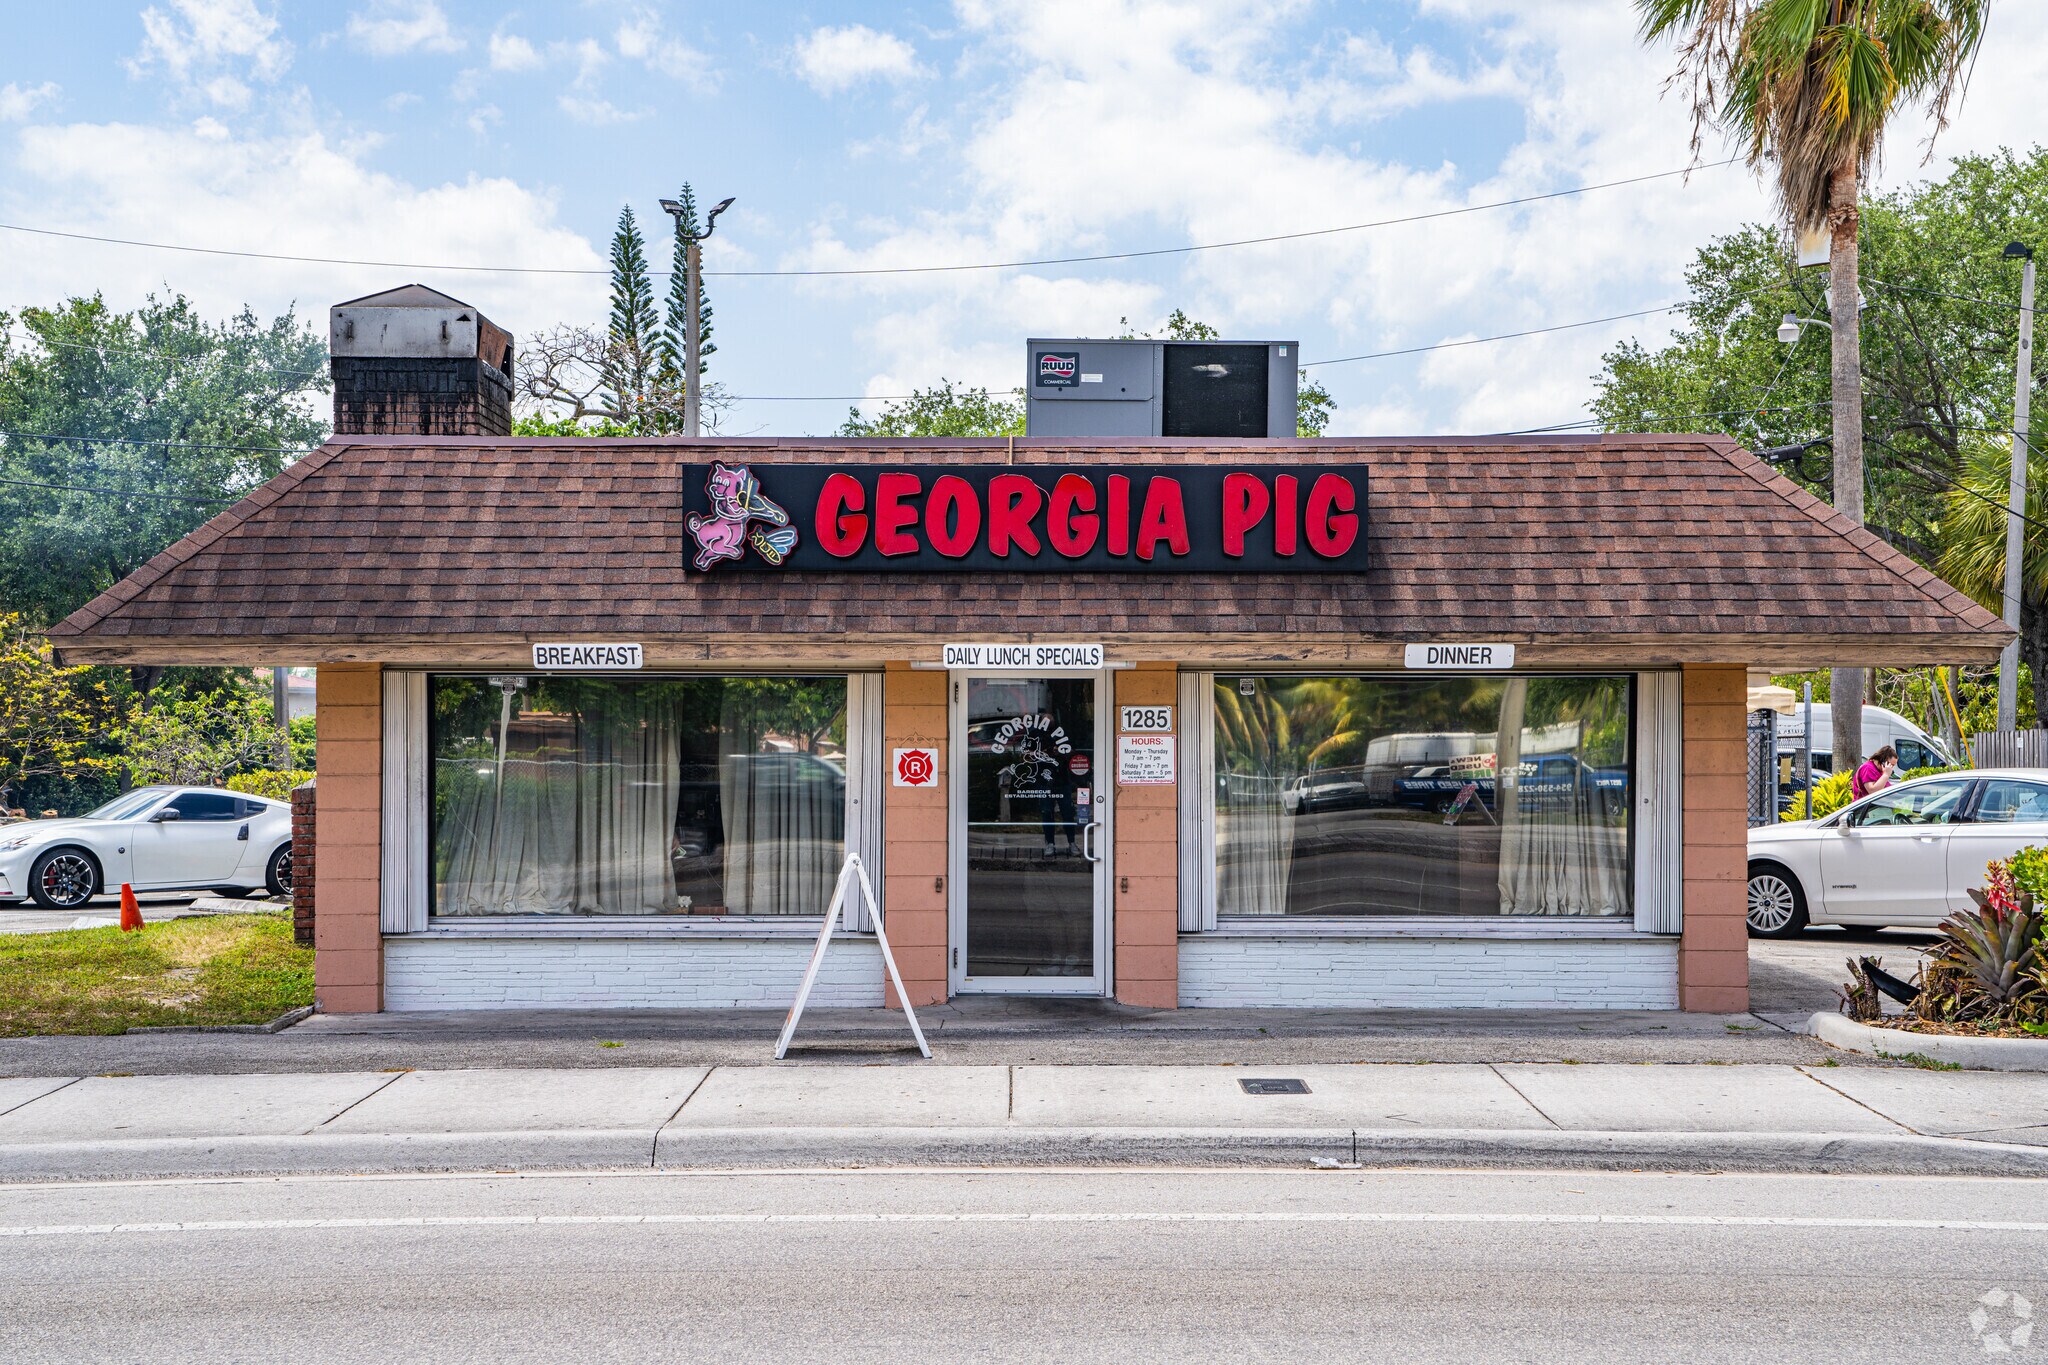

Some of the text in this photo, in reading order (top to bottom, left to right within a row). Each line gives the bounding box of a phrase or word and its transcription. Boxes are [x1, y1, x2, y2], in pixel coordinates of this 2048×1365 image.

[1041, 361, 1074, 371] RUUD
[814, 471, 1359, 560] GEORGIA PIG
[536, 646, 638, 667] BREAKFAST
[946, 647, 1100, 666] DAILY LUNCH SPECIALS
[1426, 646, 1493, 665] DINNER
[1124, 709, 1168, 728] 1285
[990, 714, 1072, 754] GEORGIA PIG
[1131, 738, 1164, 746] HOURS:
[910, 761, 921, 774] R
